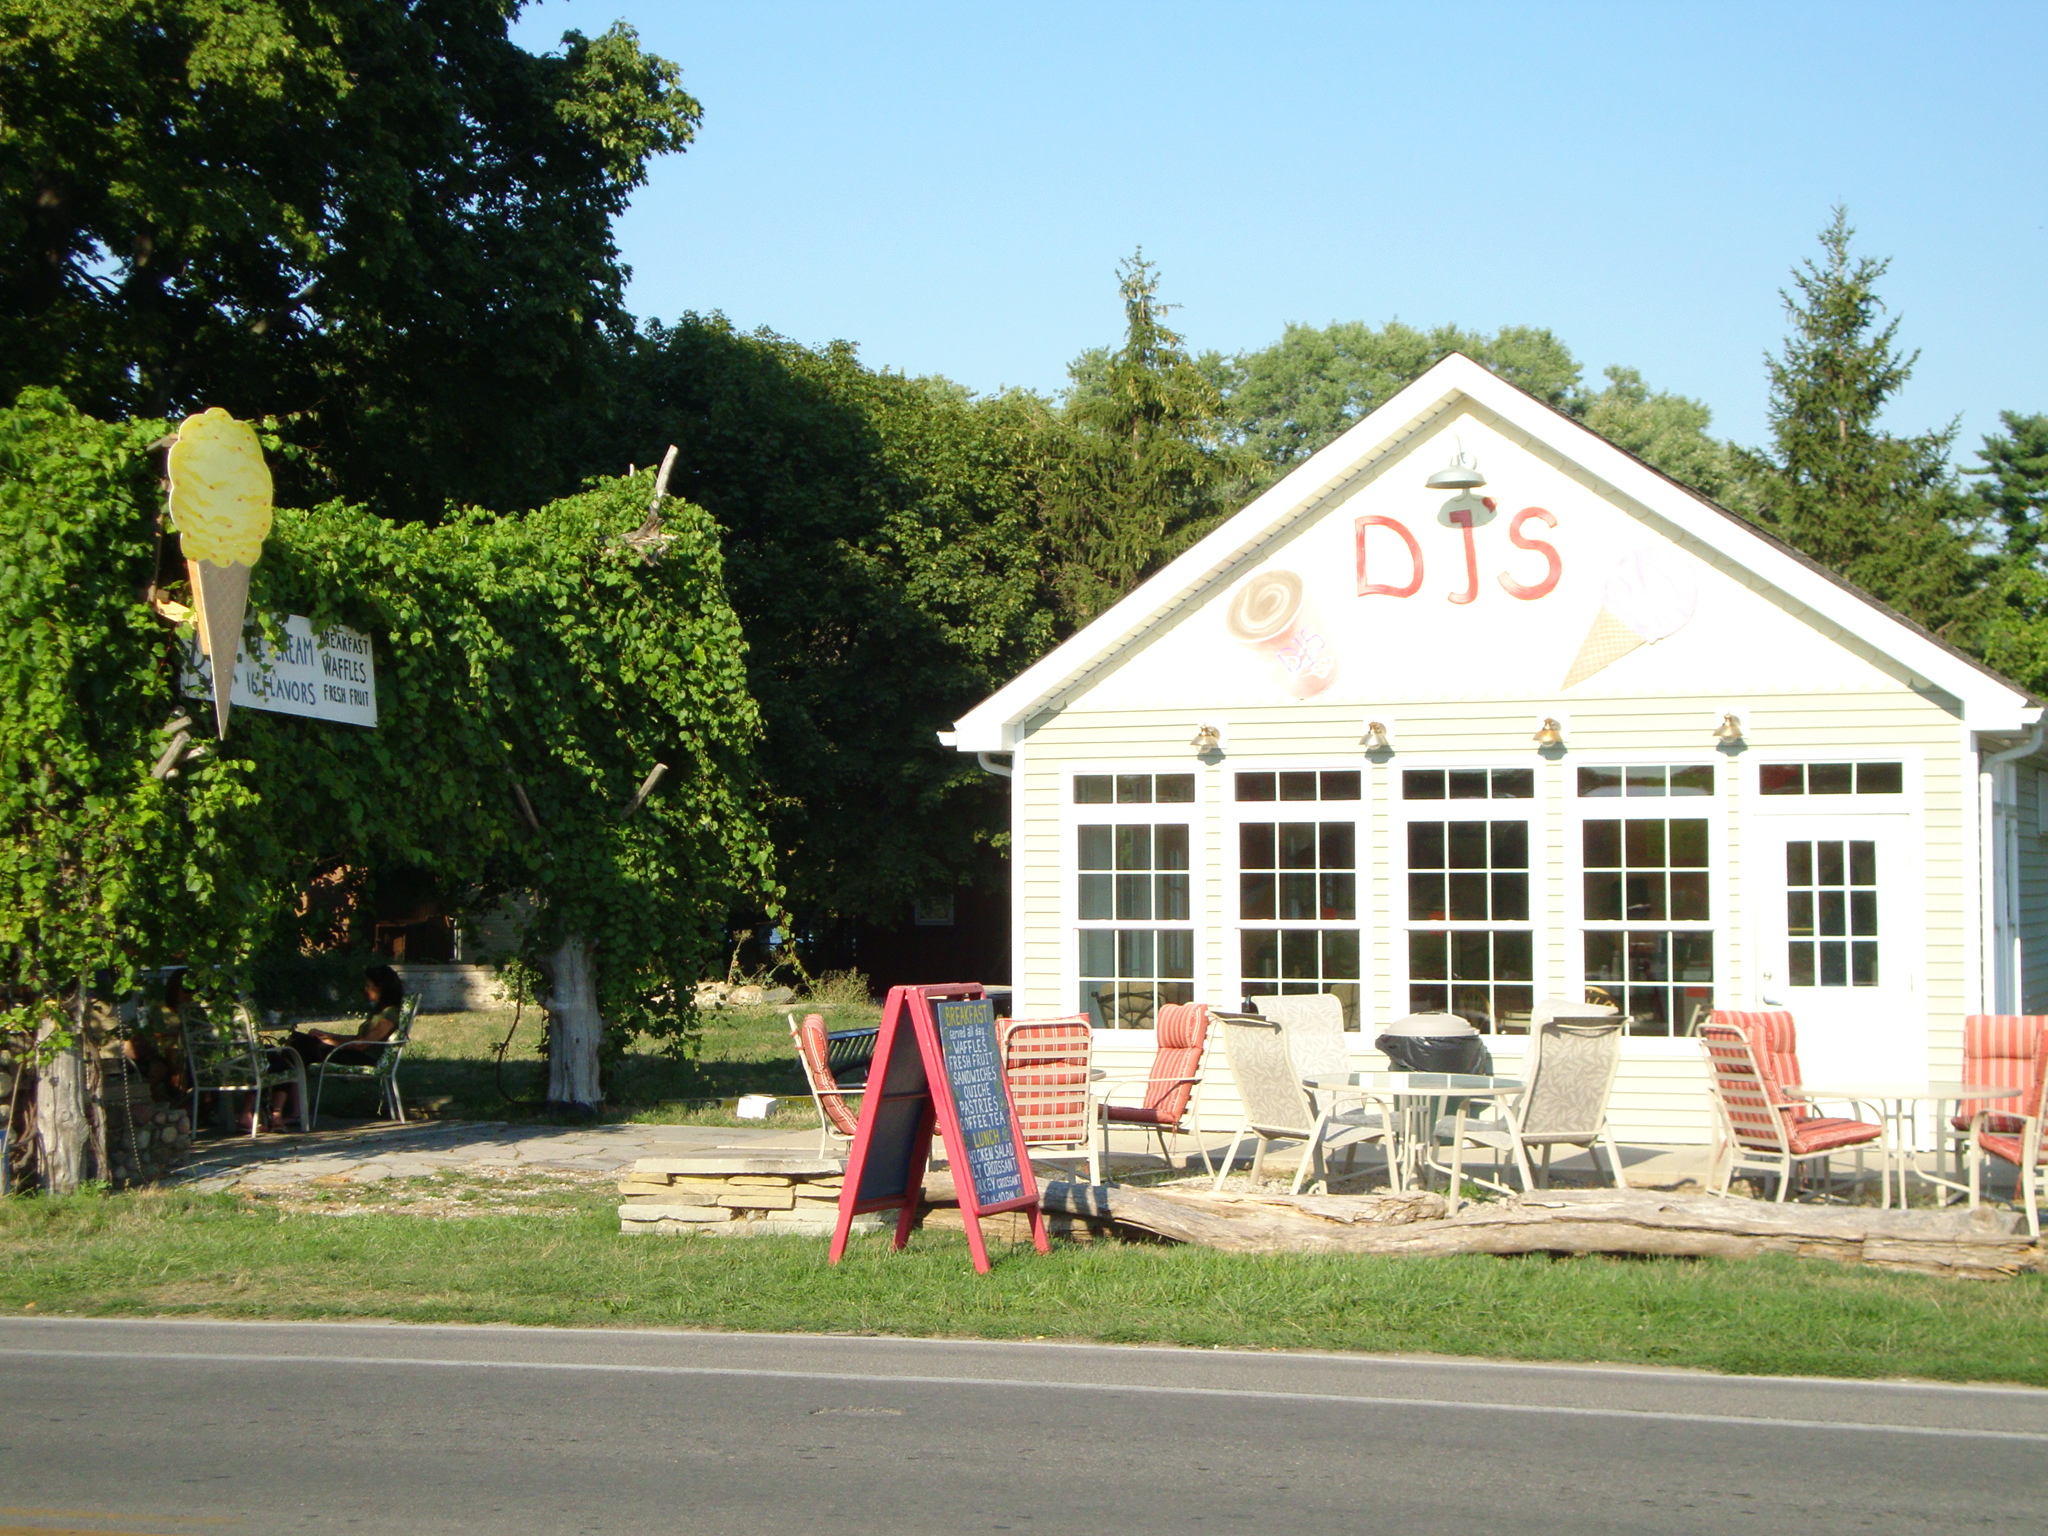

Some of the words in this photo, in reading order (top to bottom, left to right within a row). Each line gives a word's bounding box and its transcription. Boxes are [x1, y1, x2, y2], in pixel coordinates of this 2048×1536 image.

[275, 634, 314, 666] EAM
[321, 653, 367, 683] WAFFLES
[262, 678, 317, 706] FLAVORS
[323, 684, 346, 705] FRESH
[350, 690, 369, 707] FRUIT
[944, 1004, 988, 1027] BREAKFAST
[949, 1025, 966, 1040] served
[952, 1039, 988, 1055] WAFFLES
[948, 1054, 972, 1070] FRESH
[972, 1052, 993, 1065] FRUIT
[953, 1066, 997, 1086] SANDWICHES
[963, 1082, 992, 1099] QUICHE
[959, 1095, 999, 1116] PASTRIES
[972, 1128, 1001, 1148] LUNCH
[968, 1146, 994, 1164] HICKEN
[994, 1142, 1015, 1160] SALAD
[971, 1163, 983, 1179] LT
[983, 1157, 1017, 1177] CROISSANT
[975, 1177, 996, 1195] RKEY
[996, 1174, 1021, 1189] CROISSANT
